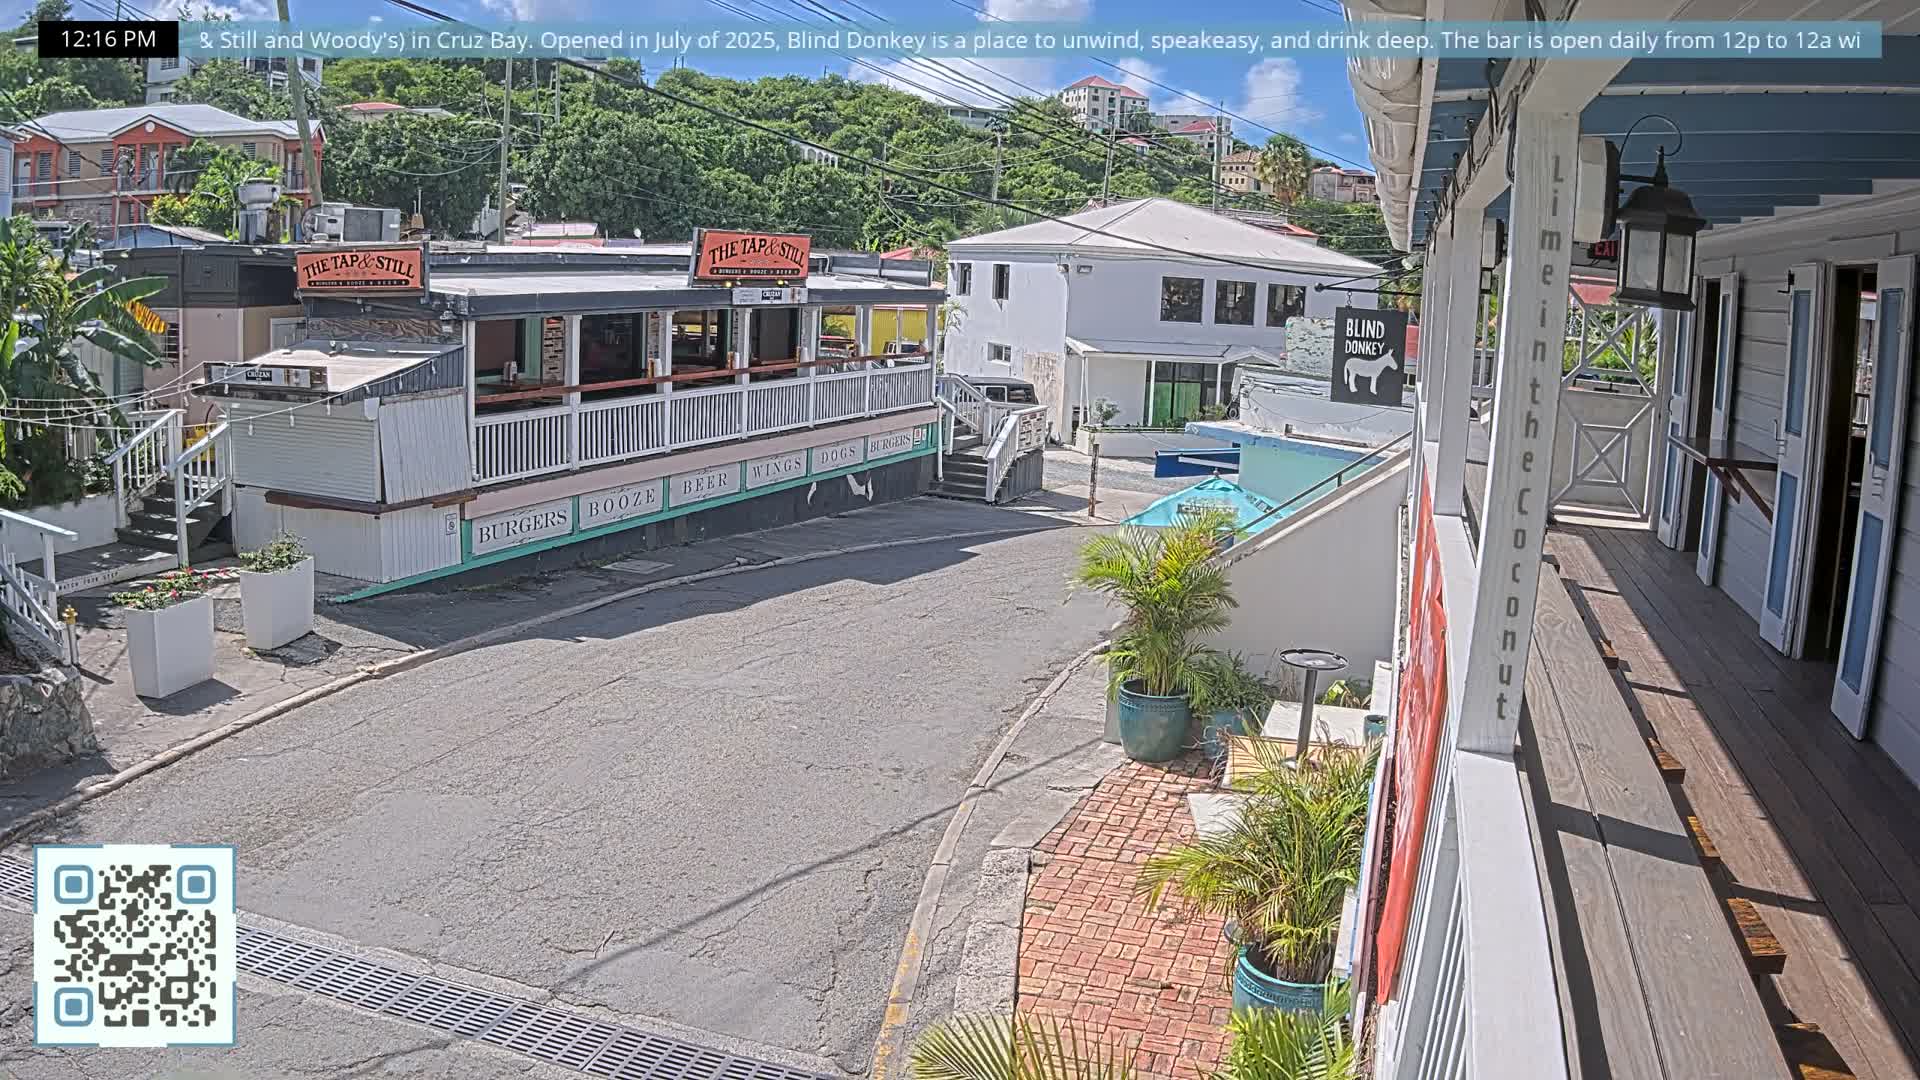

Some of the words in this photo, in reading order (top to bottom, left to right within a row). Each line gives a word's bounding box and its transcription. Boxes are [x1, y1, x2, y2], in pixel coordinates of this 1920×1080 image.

[708, 240, 739, 264] THE
[740, 237, 767, 255] TAP
[764, 238, 780, 256] &
[779, 241, 805, 268] STILL
[303, 258, 330, 279] THE
[331, 254, 360, 270] TAP
[358, 253, 376, 270] &
[375, 255, 415, 279] STILL
[1346, 318, 1385, 339] BLIND
[1345, 340, 1385, 356] DONKEY
[870, 433, 911, 453] BURGERS
[821, 445, 857, 464] DOGS
[752, 457, 801, 478] WINGS
[683, 473, 728, 495] BEER
[588, 488, 656, 517] BOOZE
[479, 509, 568, 544] BURGERS
